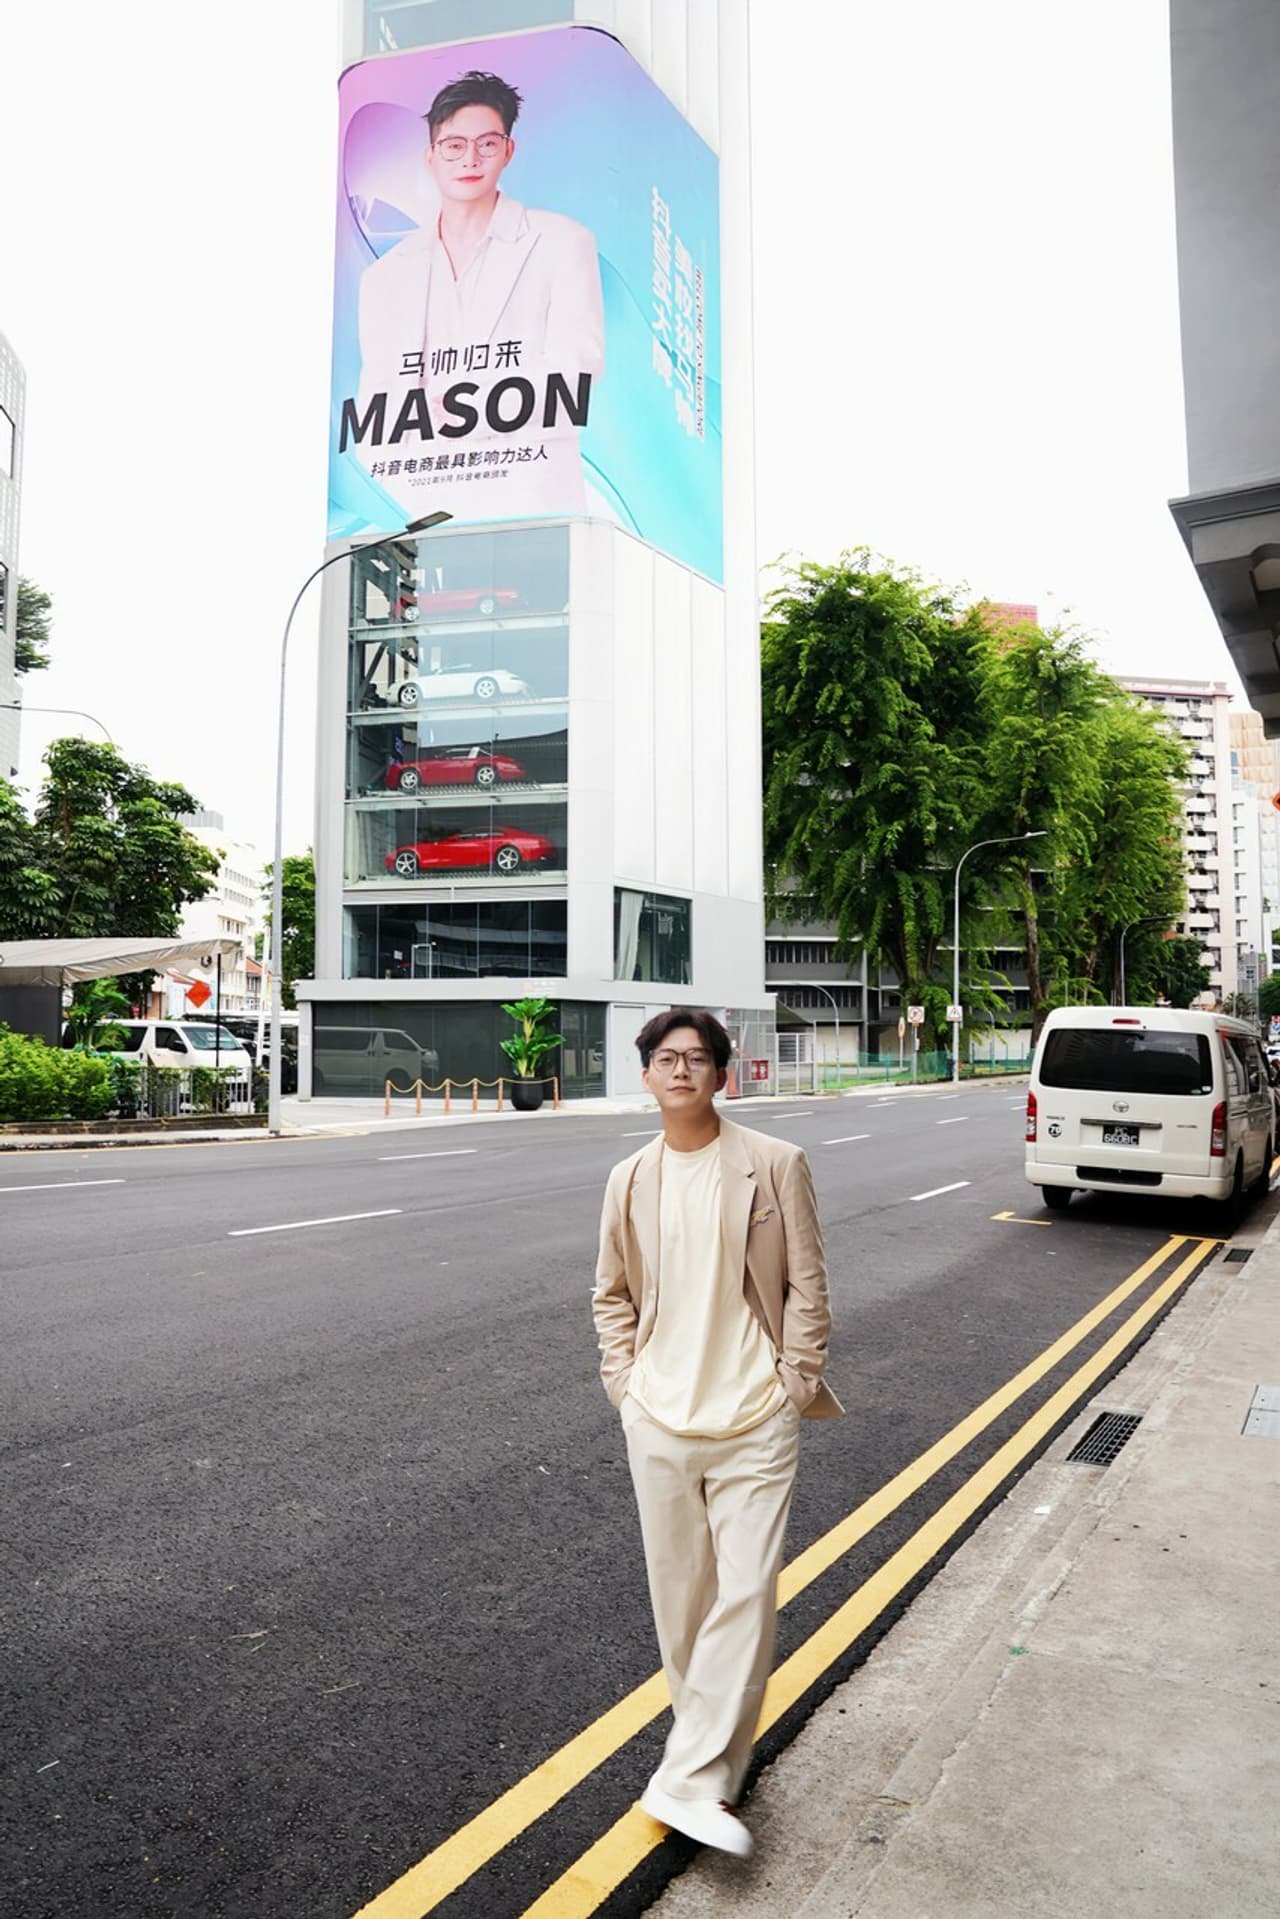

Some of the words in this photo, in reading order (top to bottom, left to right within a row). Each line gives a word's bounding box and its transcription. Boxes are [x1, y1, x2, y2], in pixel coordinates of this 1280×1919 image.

[399, 339, 523, 378] 马帅归来
[338, 371, 593, 454] MASON
[370, 444, 549, 478] 抖音电商最具影响力达人
